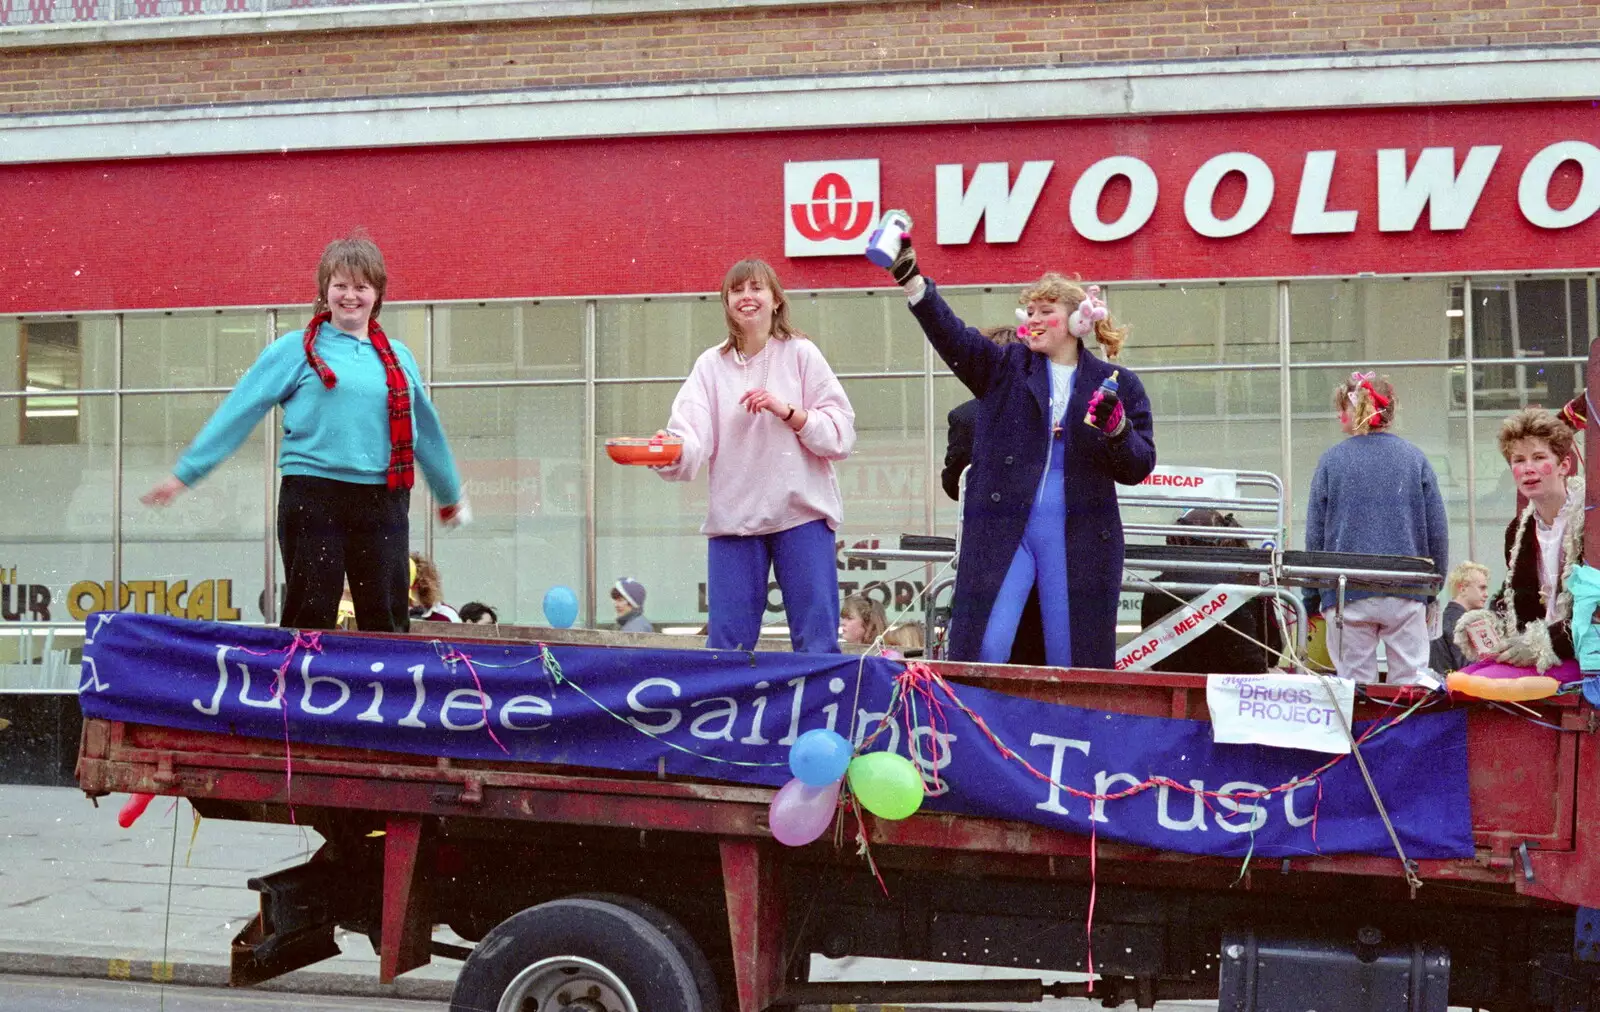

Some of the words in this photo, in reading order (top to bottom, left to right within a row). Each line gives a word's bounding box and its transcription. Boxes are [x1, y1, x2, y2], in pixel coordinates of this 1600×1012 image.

[935, 140, 1600, 245] WOOLWO
[1141, 474, 1204, 487] MENCAP
[66, 579, 241, 621] OPTICAL
[1113, 639, 1159, 670] ENCAP
[1173, 593, 1228, 635] MENCAP
[1239, 700, 1336, 726] PROJECT
[1240, 683, 1312, 704] DRUGS
[192, 644, 552, 731] Jubilee
[626, 676, 957, 796] Sailing
[1030, 732, 1317, 833] Trust
